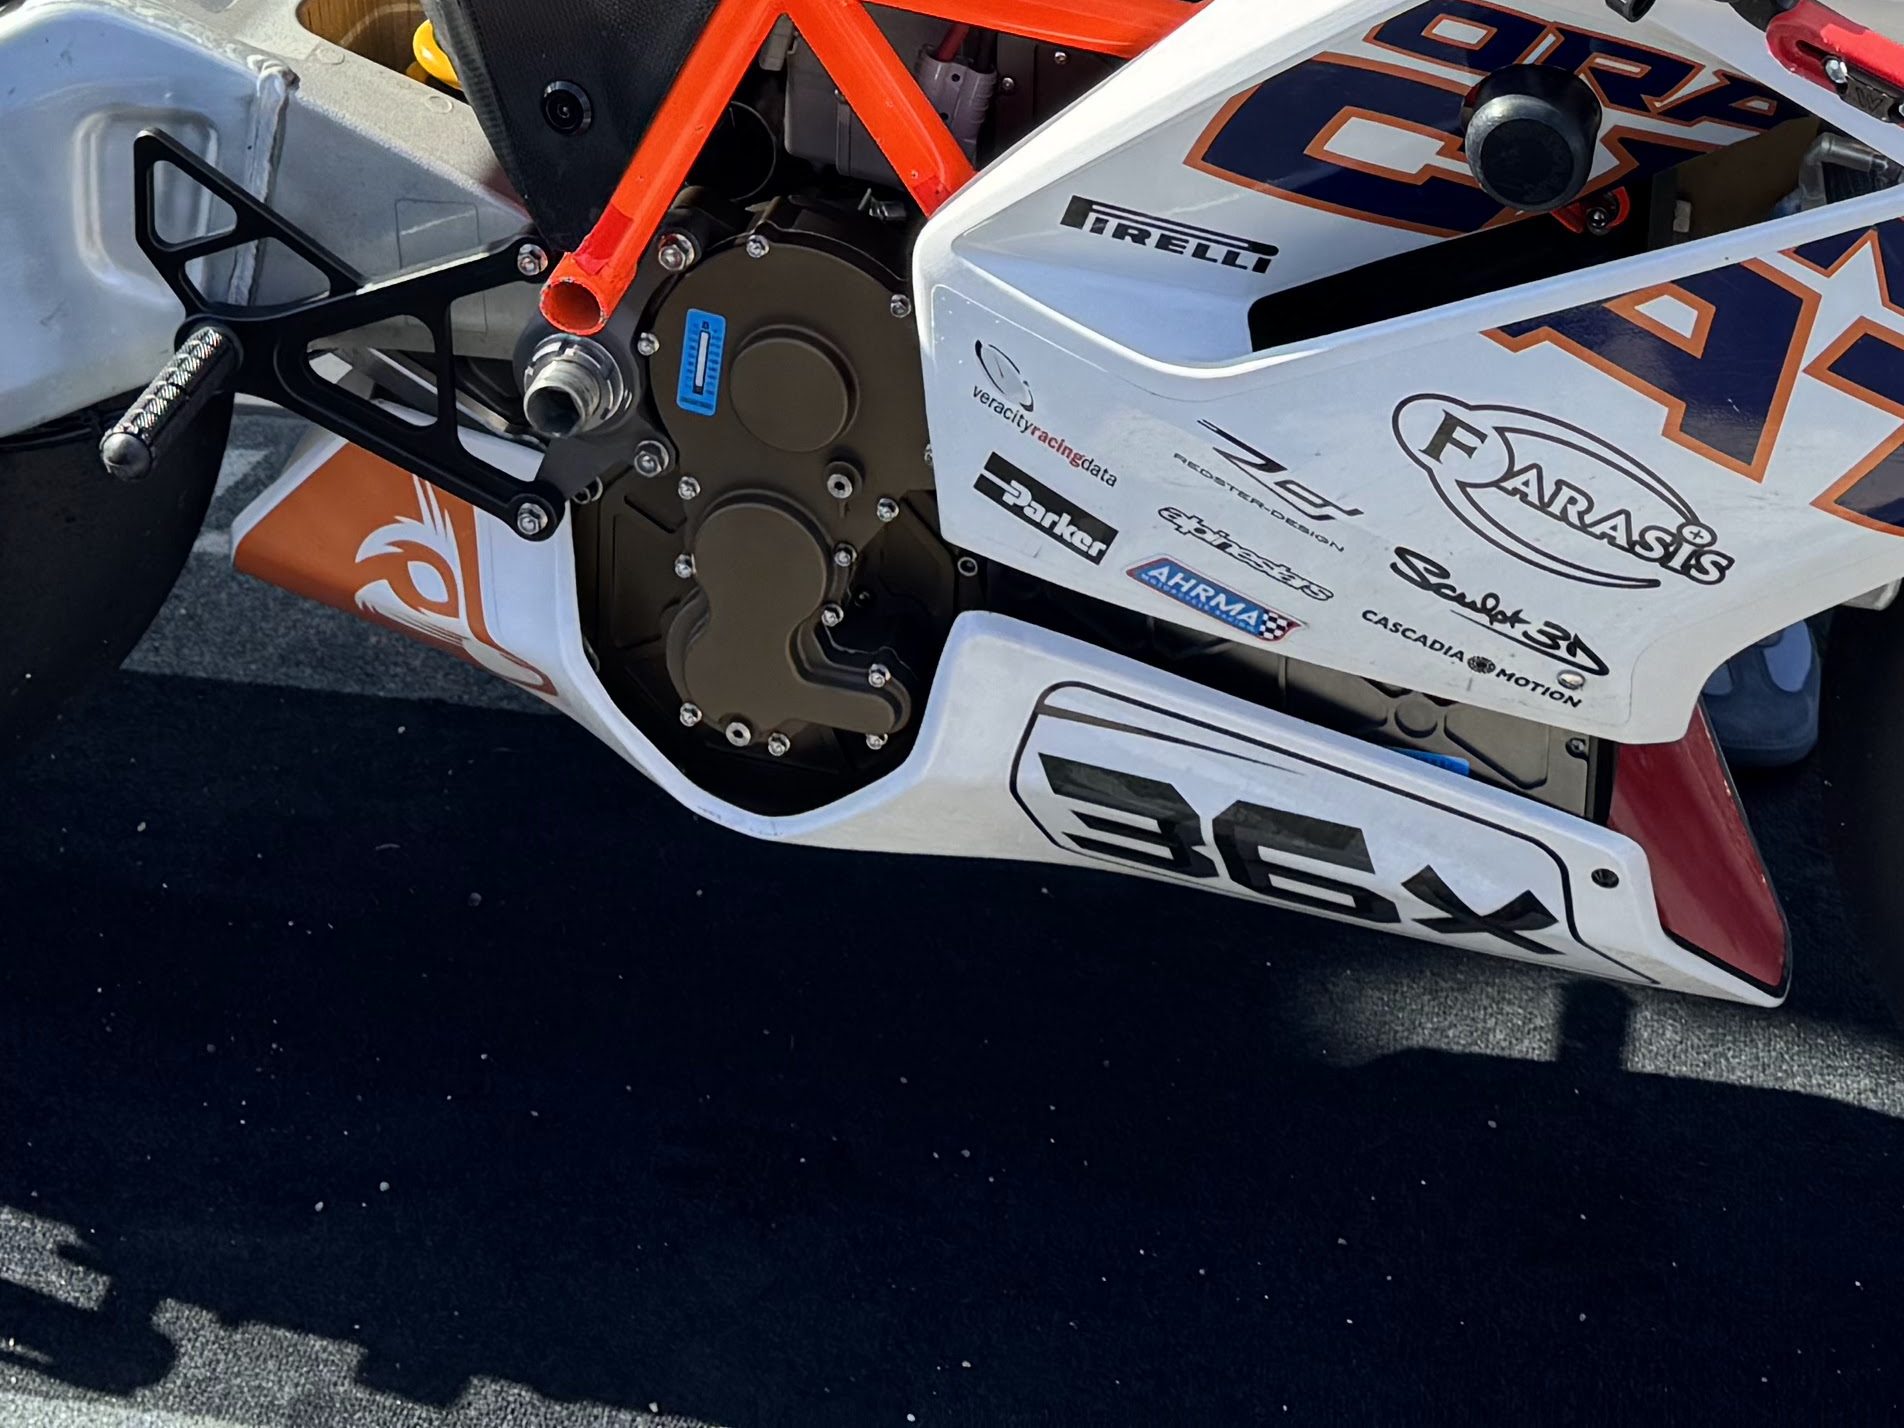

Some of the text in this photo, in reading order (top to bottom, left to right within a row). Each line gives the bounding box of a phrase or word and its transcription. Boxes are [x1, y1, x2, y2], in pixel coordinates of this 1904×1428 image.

[1060, 194, 1280, 275] PIRELLI
[972, 385, 1118, 488] veracityracingdata
[996, 478, 1108, 558] Parker
[1173, 452, 1345, 552] REDSTER-DESIGN
[1418, 408, 1736, 586] FARASIS
[1147, 564, 1259, 628] AHRMA
[1390, 546, 1610, 678] Sculpt 3D
[1362, 609, 1583, 709] CASCADIA MOTION
